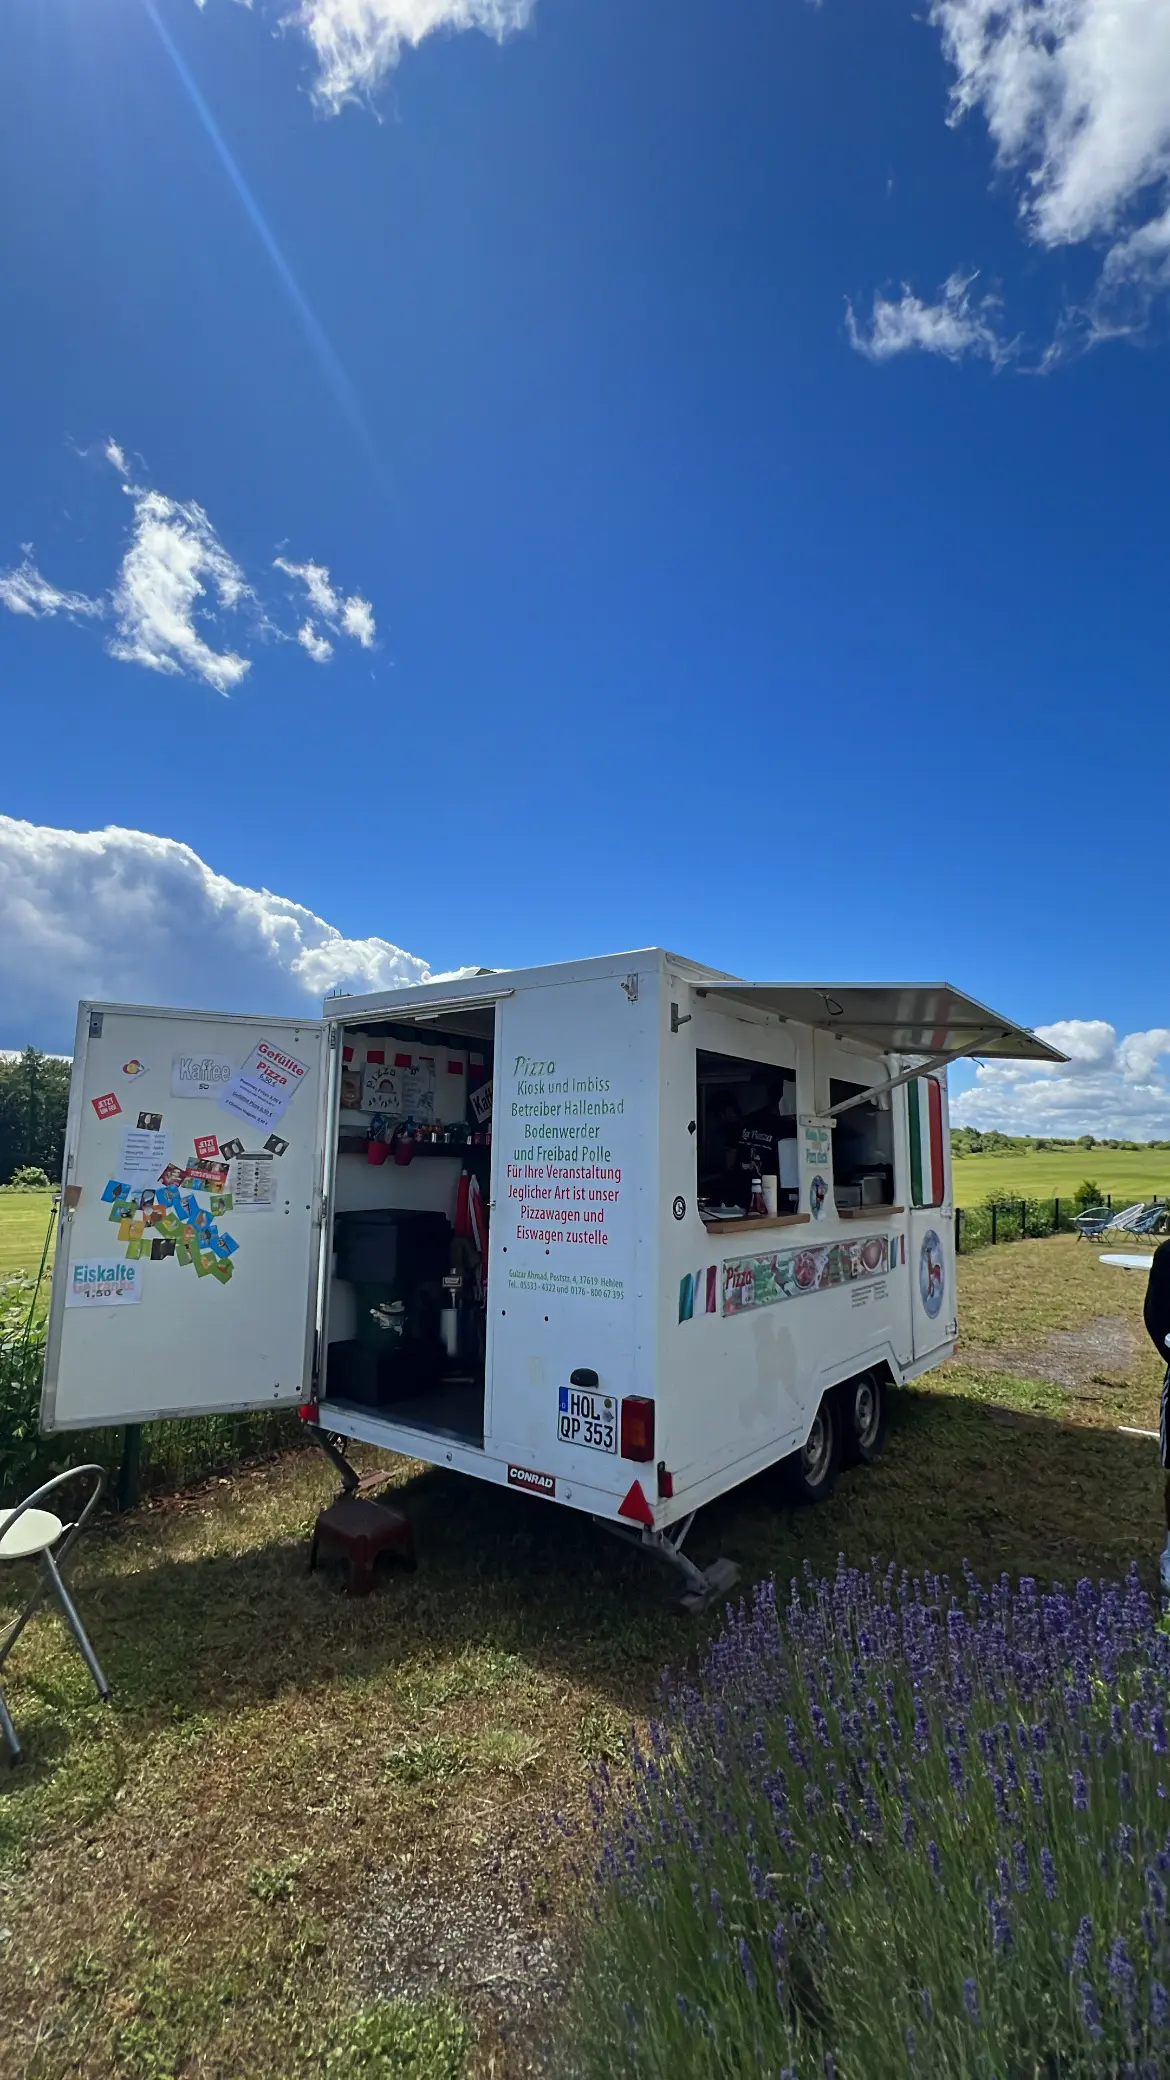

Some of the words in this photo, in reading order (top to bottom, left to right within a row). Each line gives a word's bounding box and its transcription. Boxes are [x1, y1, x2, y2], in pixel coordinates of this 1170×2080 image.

[258, 1043, 305, 1076] Gefüllte
[513, 1056, 555, 1076] Pizza
[180, 1058, 231, 1082] Kaffee
[256, 1061, 288, 1085] Pizza
[517, 1079, 545, 1095] Kiosk
[548, 1078, 569, 1093] und
[572, 1077, 610, 1092] Imbiss
[511, 1101, 561, 1117] Betreiber
[564, 1099, 624, 1115] Hallenbad
[524, 1123, 600, 1139] Bodenwerder
[514, 1146, 534, 1161] und
[537, 1146, 578, 1161] Freibad
[582, 1146, 611, 1162] Polle
[507, 1164, 522, 1178] Für
[524, 1164, 544, 1178] Ihre
[546, 1165, 622, 1183] Veranstaltung
[508, 1184, 552, 1202] Jeglicher
[554, 1185, 570, 1200] Art
[573, 1186, 585, 1200] ist
[588, 1190, 619, 1201] unser
[521, 1205, 580, 1224] Pizzawagen
[583, 1208, 604, 1223] und
[517, 1225, 563, 1244] Eiswagen
[566, 1230, 608, 1245] zustelle
[74, 1263, 135, 1283] Eiskalte
[726, 1264, 754, 1290] Pizza
[84, 1289, 111, 1299] 1,50
[116, 1288, 123, 1296] €
[556, 1286, 568, 1294] und
[571, 1393, 600, 1420] HOL
[561, 1416, 580, 1439] QP
[584, 1421, 613, 1448] 353
[510, 1468, 553, 1488] CONRAD
